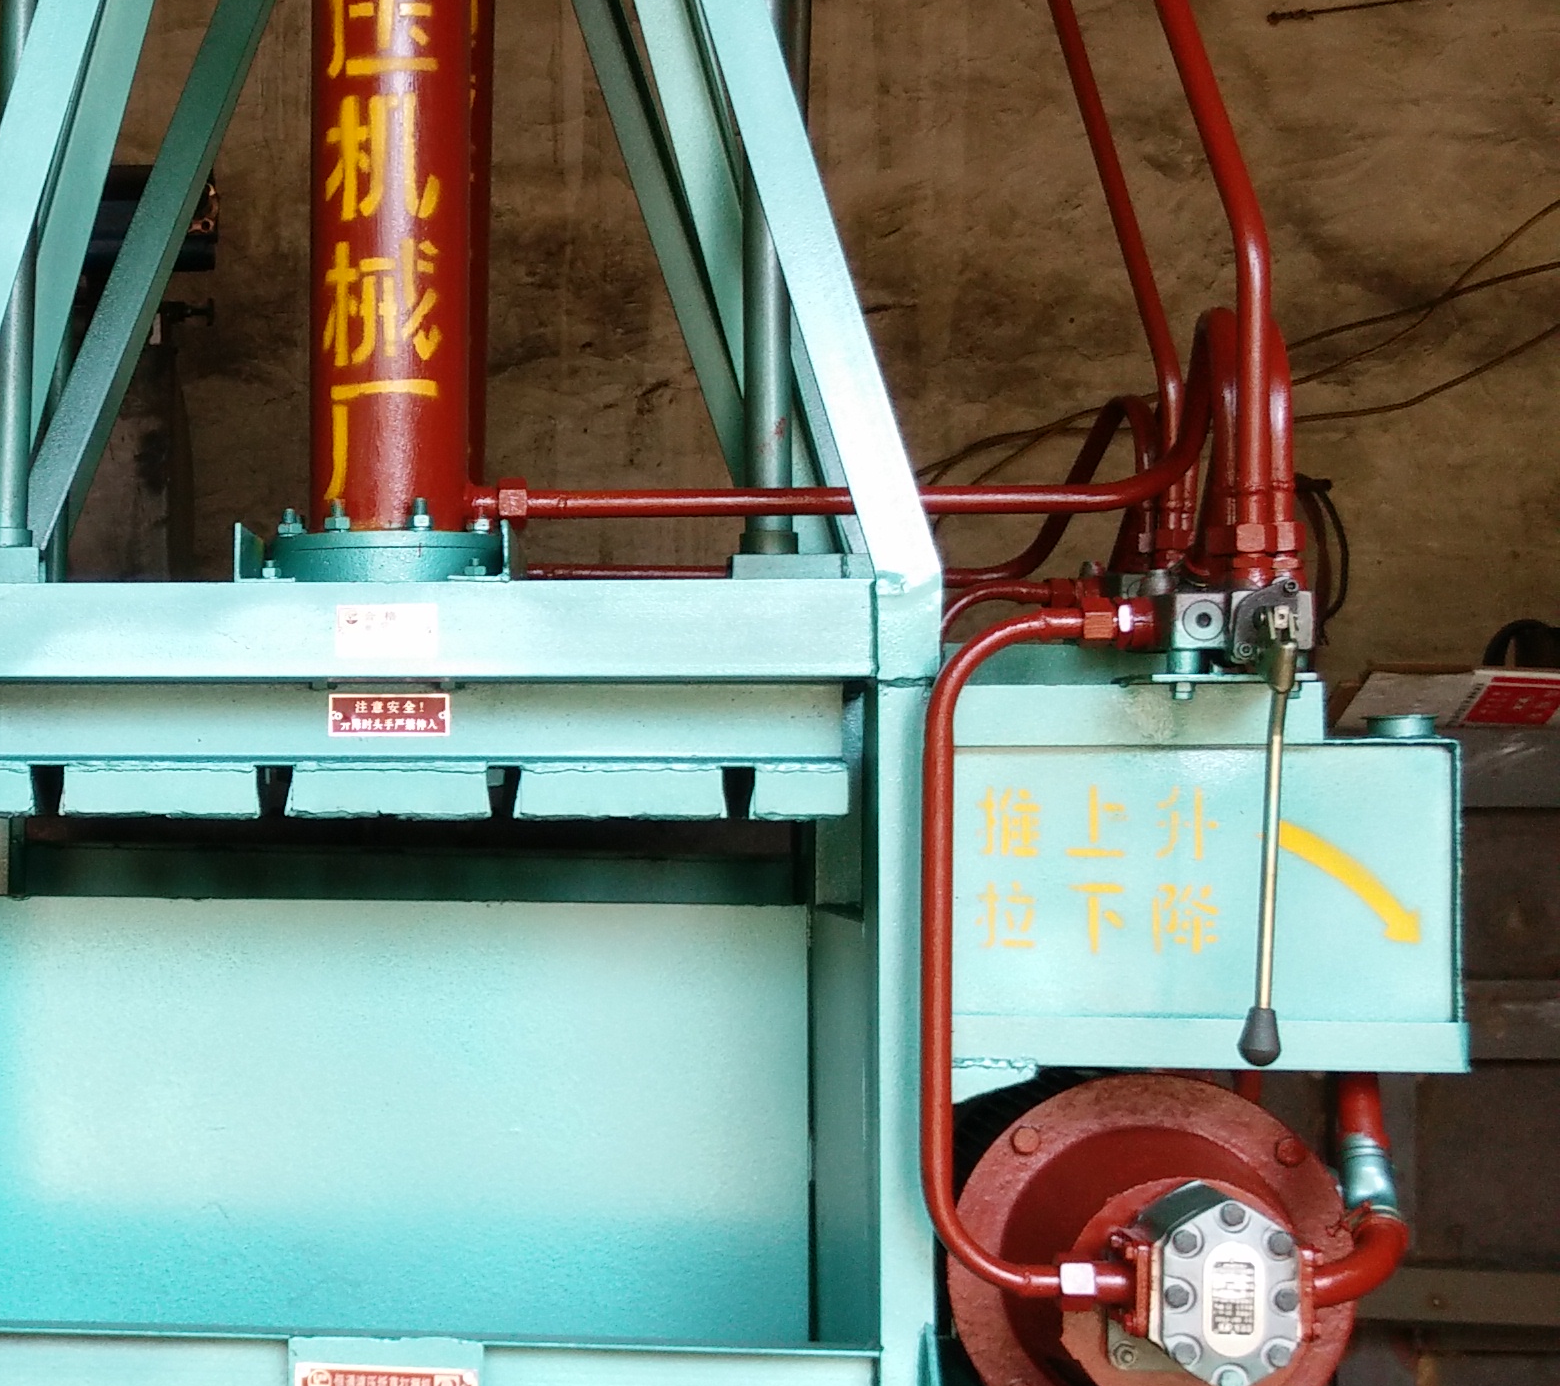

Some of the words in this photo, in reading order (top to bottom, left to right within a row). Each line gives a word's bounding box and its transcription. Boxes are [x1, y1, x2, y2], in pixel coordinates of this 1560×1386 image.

[976, 783, 1219, 861] 推上升
[975, 881, 1220, 955] 拉下降
